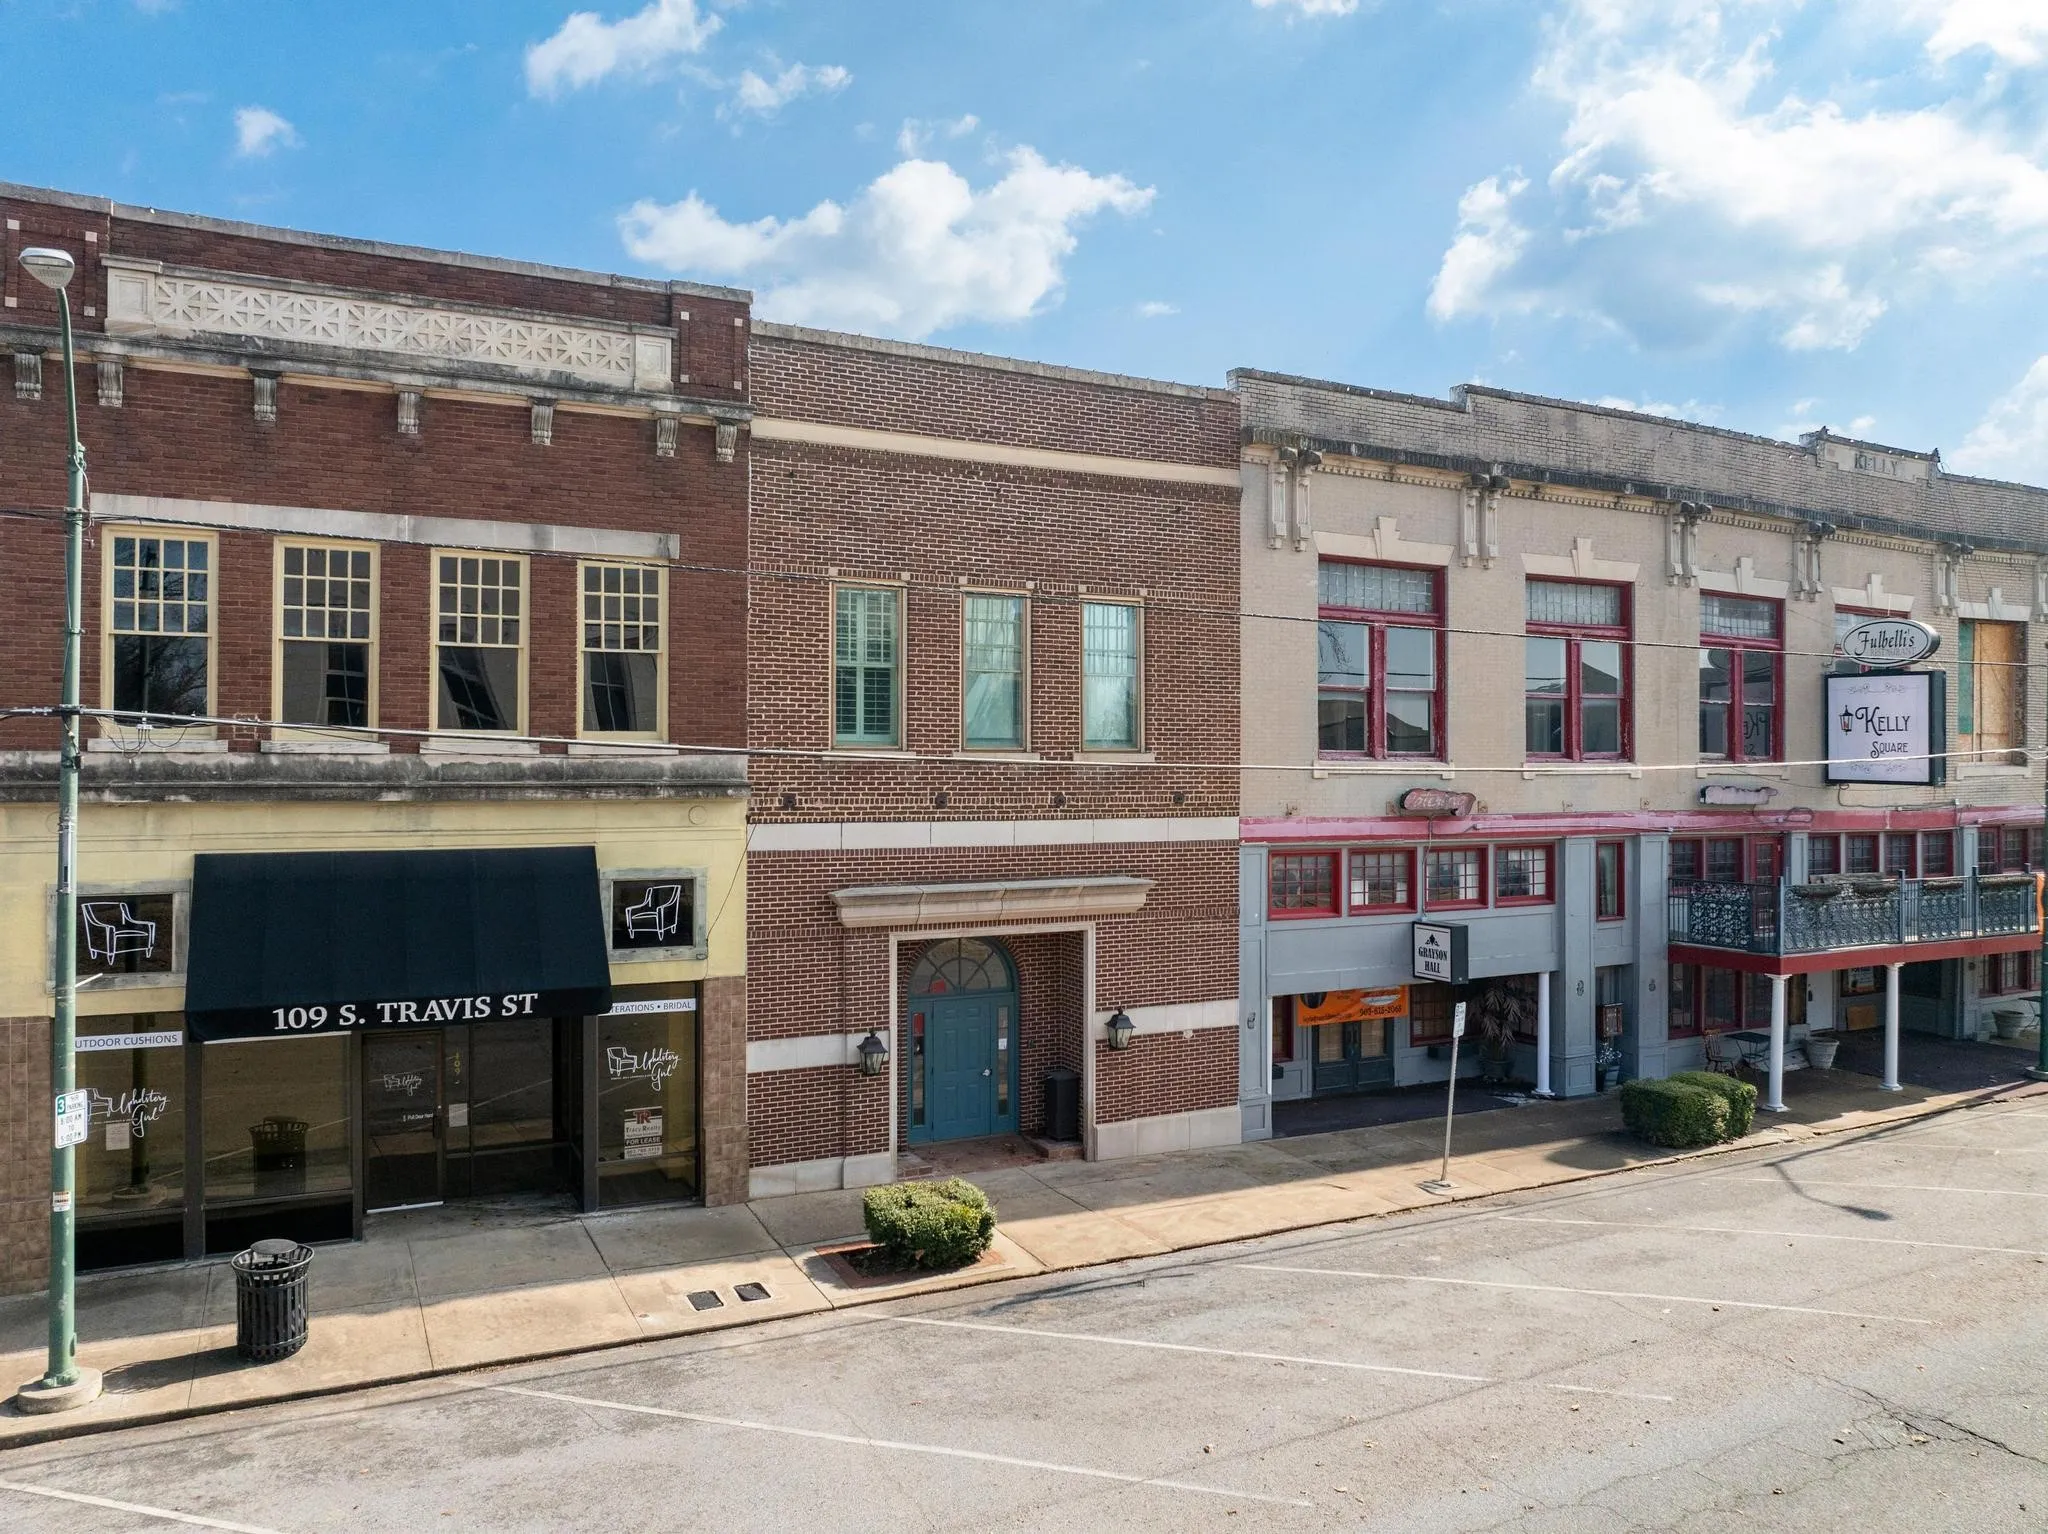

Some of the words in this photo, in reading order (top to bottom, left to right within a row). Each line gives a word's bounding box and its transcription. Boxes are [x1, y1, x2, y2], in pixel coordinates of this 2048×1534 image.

[1854, 453, 1899, 476] KELLY
[1854, 628, 1915, 656] Fulbelli's
[1855, 706, 1911, 736] KELLY
[1870, 741, 1909, 759] SQUARE
[1418, 946, 1448, 961] GRAYSON
[1424, 961, 1441, 974] HALL
[272, 1006, 328, 1030] 109
[339, 1004, 366, 1026] S.
[376, 996, 491, 1023] TRAVIS
[501, 993, 539, 1017] ST
[611, 1003, 655, 1013] TERATIONS
[663, 1001, 692, 1010] BRIDAL
[75, 1038, 121, 1048] UTDOOR
[123, 1034, 178, 1046] CUSHIONS
[57, 1099, 65, 1113] 3
